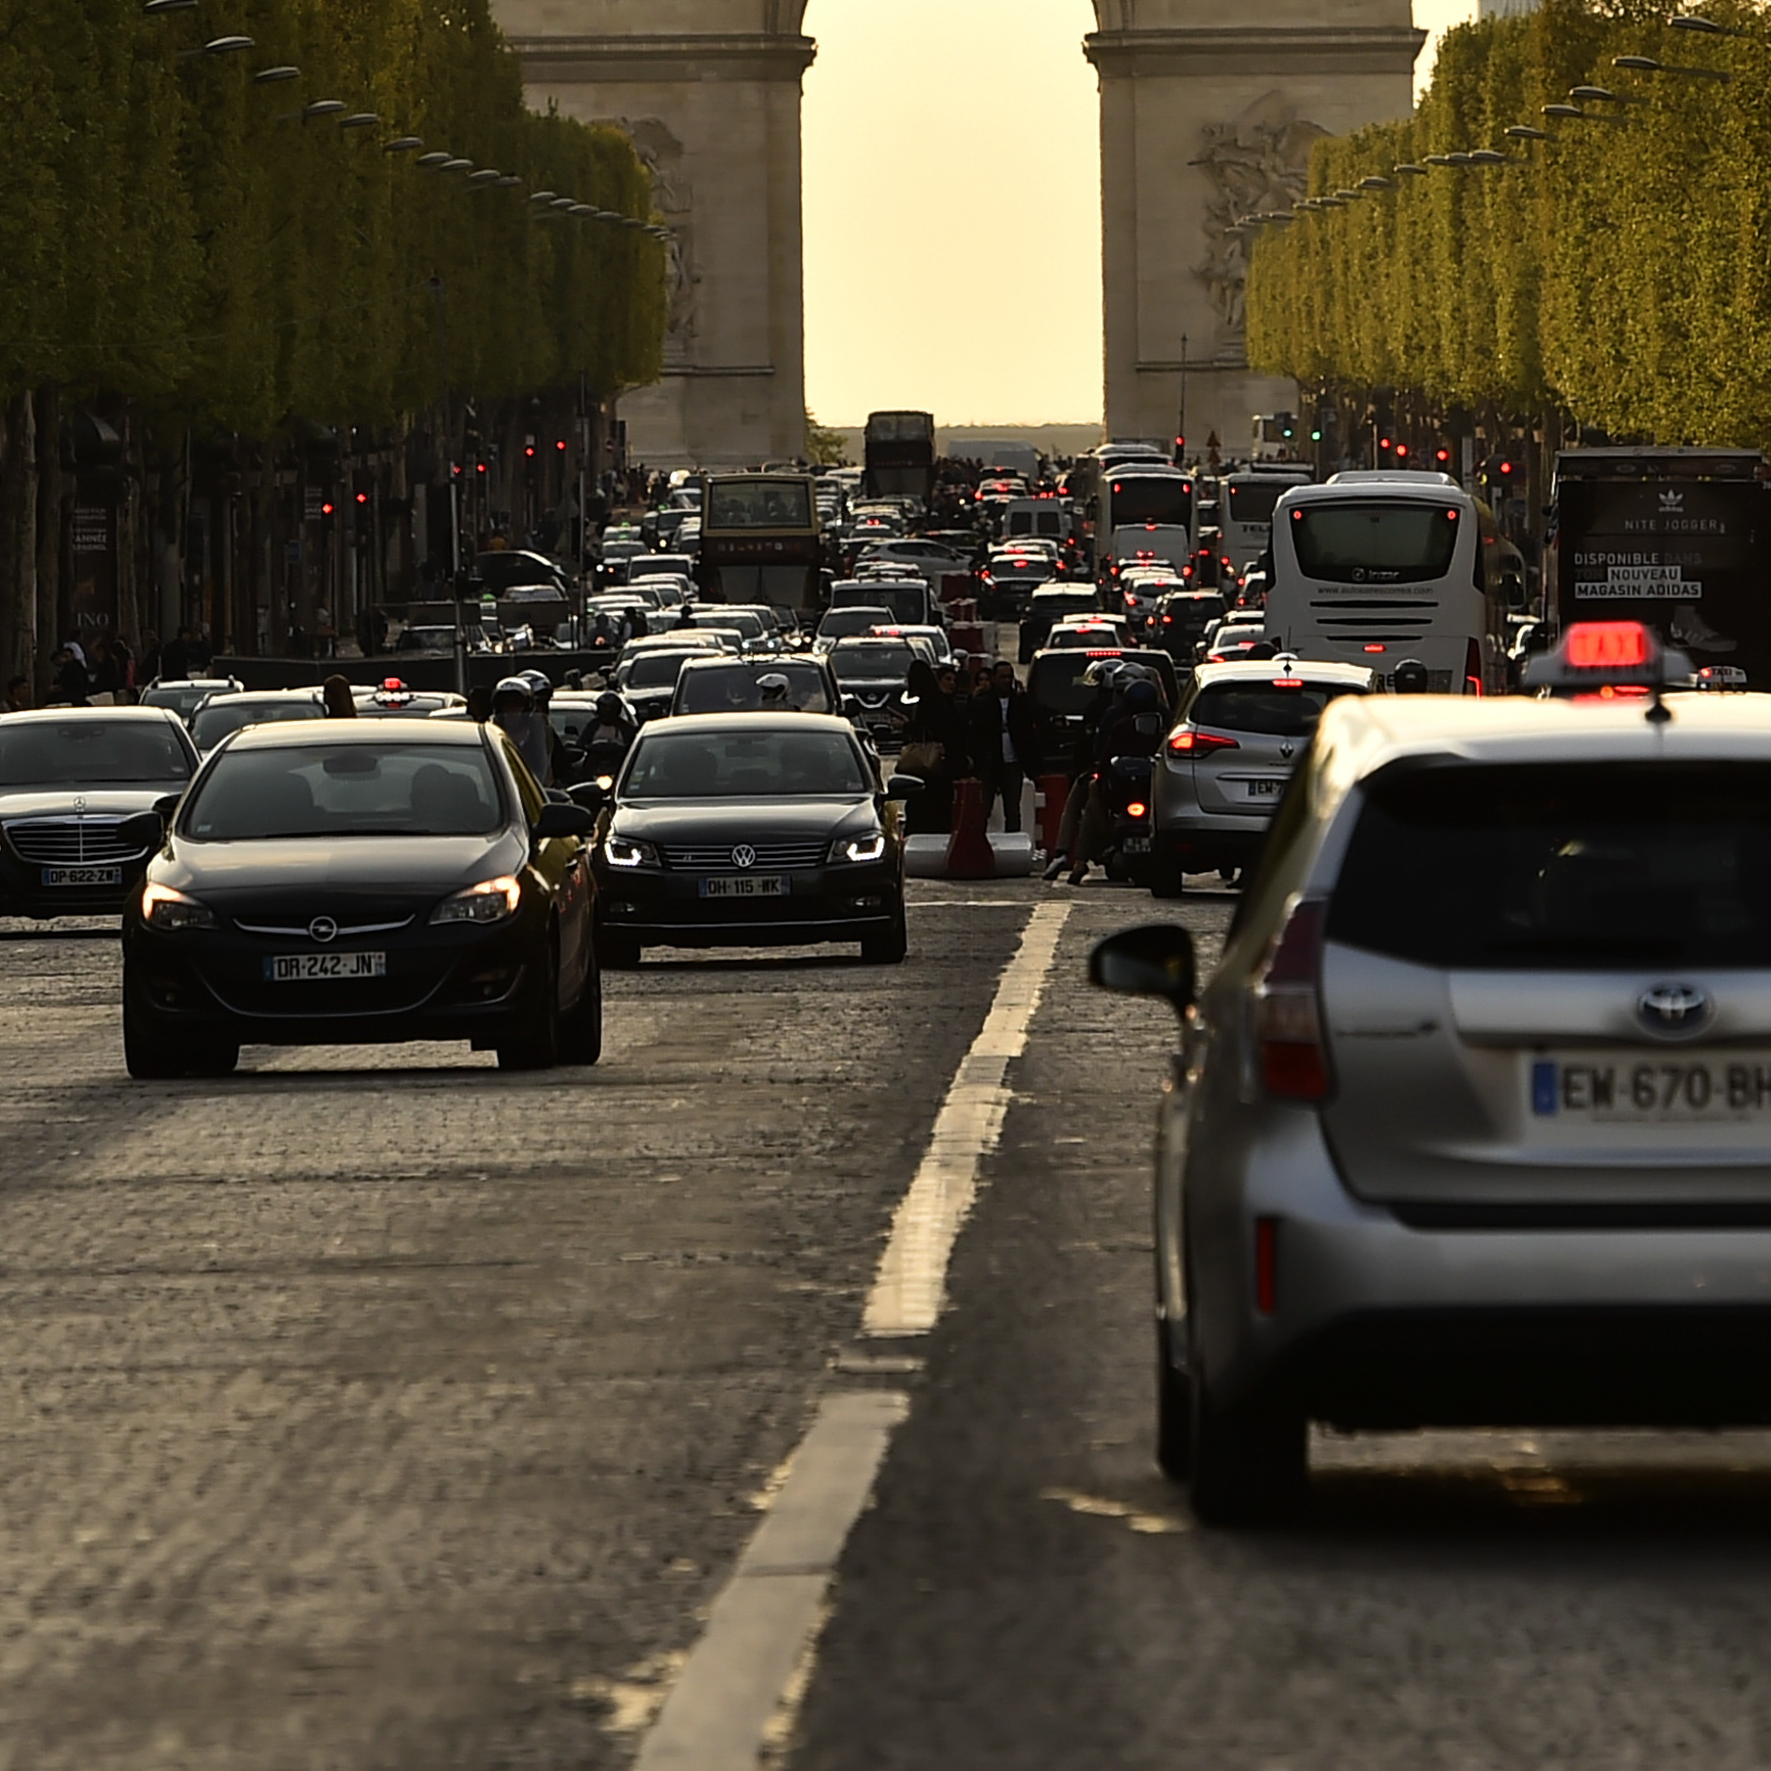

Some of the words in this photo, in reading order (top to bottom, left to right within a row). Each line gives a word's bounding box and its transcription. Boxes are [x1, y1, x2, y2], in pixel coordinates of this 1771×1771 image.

[1624, 519, 1657, 530] NITE
[1664, 519, 1718, 530] JOGGER
[1573, 552, 1660, 565] DISPONIBLE
[1611, 569, 1678, 580] NOUVEAU
[1577, 585, 1641, 596] MAGASIN
[1646, 585, 1699, 596] ADIDAS
[1574, 631, 1643, 658] TAXI
[277, 954, 373, 978] DR-242-JN
